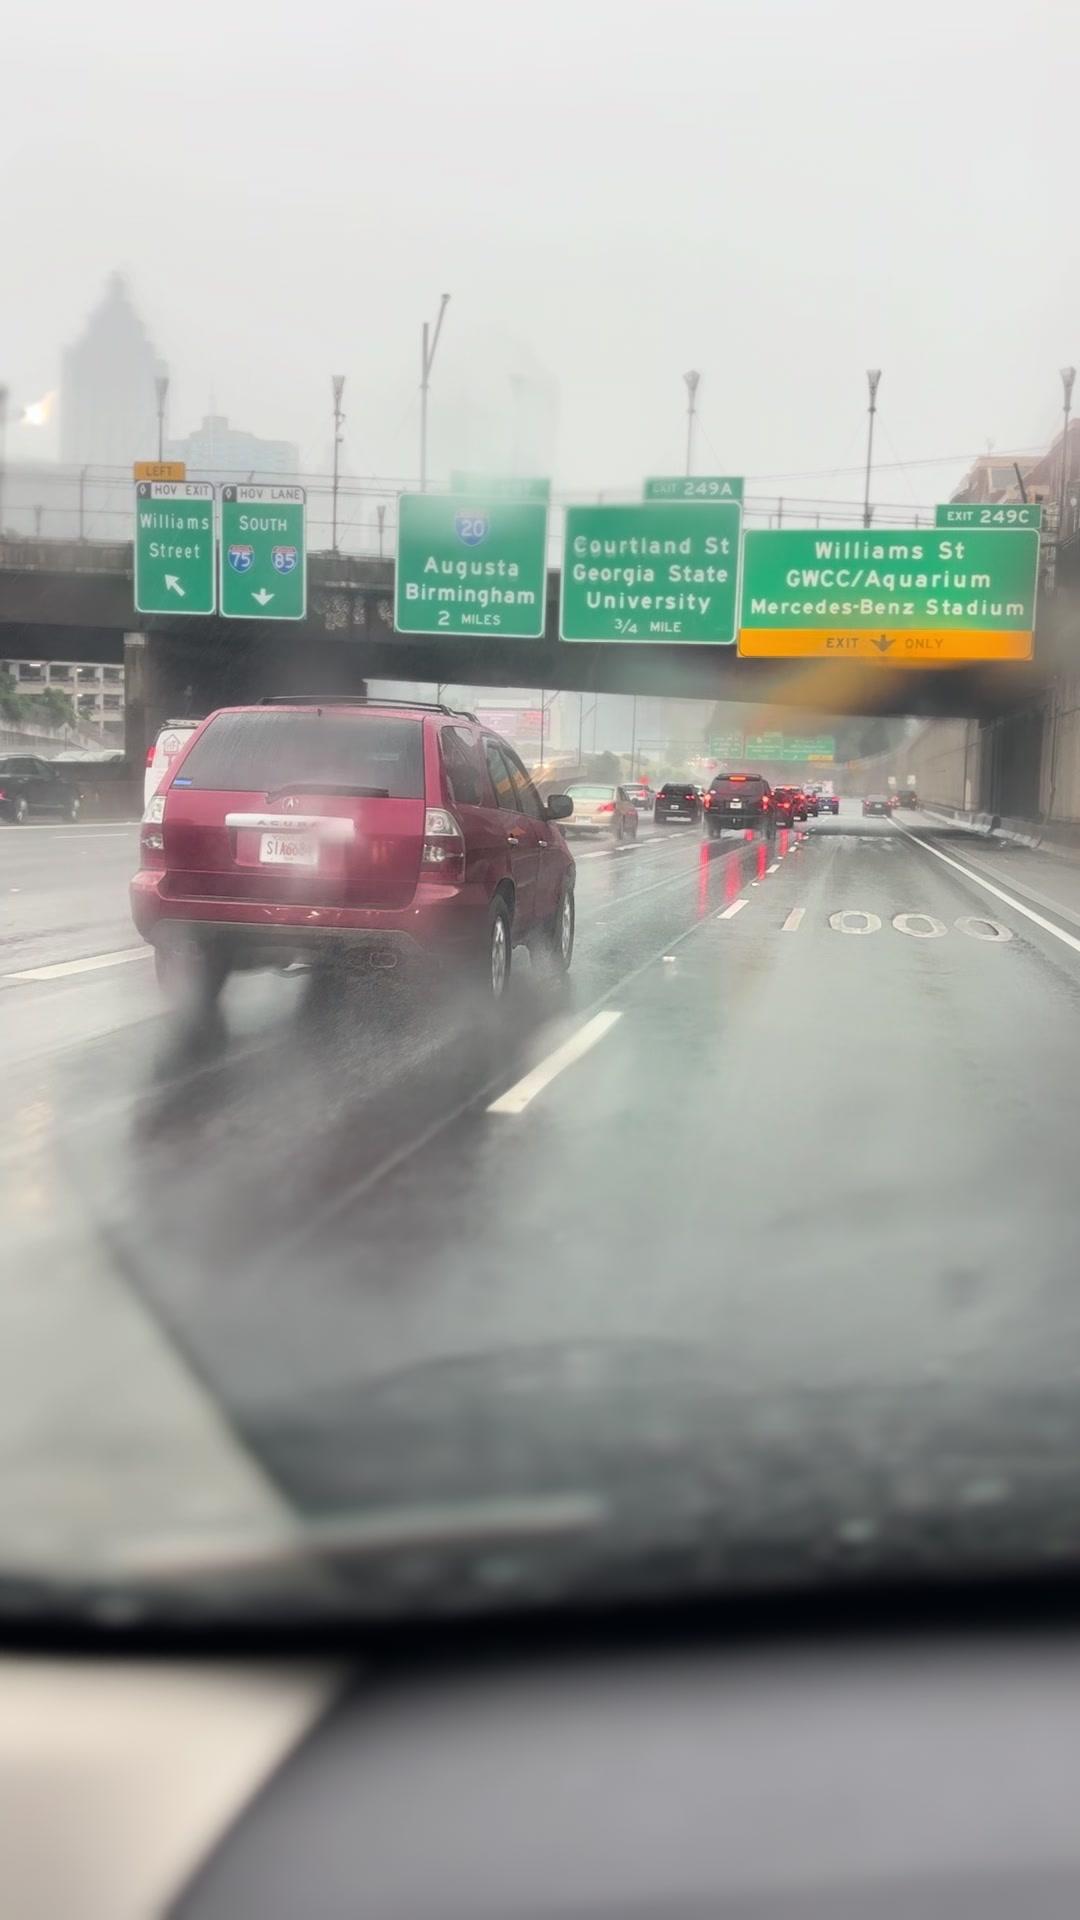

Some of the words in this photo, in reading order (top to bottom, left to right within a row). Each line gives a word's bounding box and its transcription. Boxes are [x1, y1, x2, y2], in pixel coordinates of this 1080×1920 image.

[146, 466, 172, 476] LEFT
[155, 485, 177, 495] HOV
[185, 485, 209, 496] EXIT
[240, 488, 263, 499] HOV
[271, 489, 300, 499] LANE
[653, 483, 677, 493] EXIT
[684, 481, 733, 495] 249A
[140, 513, 209, 530] Williams
[239, 515, 288, 531] SOUTH
[947, 511, 973, 522] EXIT
[980, 509, 1030, 524] 249C
[461, 519, 485, 537] 20
[149, 542, 200, 559] Street
[573, 535, 692, 555] Courtland
[705, 537, 730, 554] St
[815, 541, 924, 560] Williams
[938, 541, 965, 560] St
[231, 551, 251, 568] 75
[275, 552, 295, 569] 85
[424, 556, 519, 580] Augusta
[573, 563, 655, 587] Georgia
[668, 564, 728, 582] State
[786, 569, 991, 591] GWCC/Aquarium
[405, 583, 535, 608] Birmingham
[586, 591, 711, 615] University
[750, 597, 914, 615] Mercedes-Benz
[926, 598, 1024, 616] Stadium
[438, 611, 450, 626] 2
[462, 613, 501, 626] MILES
[614, 618, 638, 634] 3/4
[650, 621, 682, 633] MILE
[826, 638, 859, 649] EXIT
[905, 638, 944, 650] ONLY
